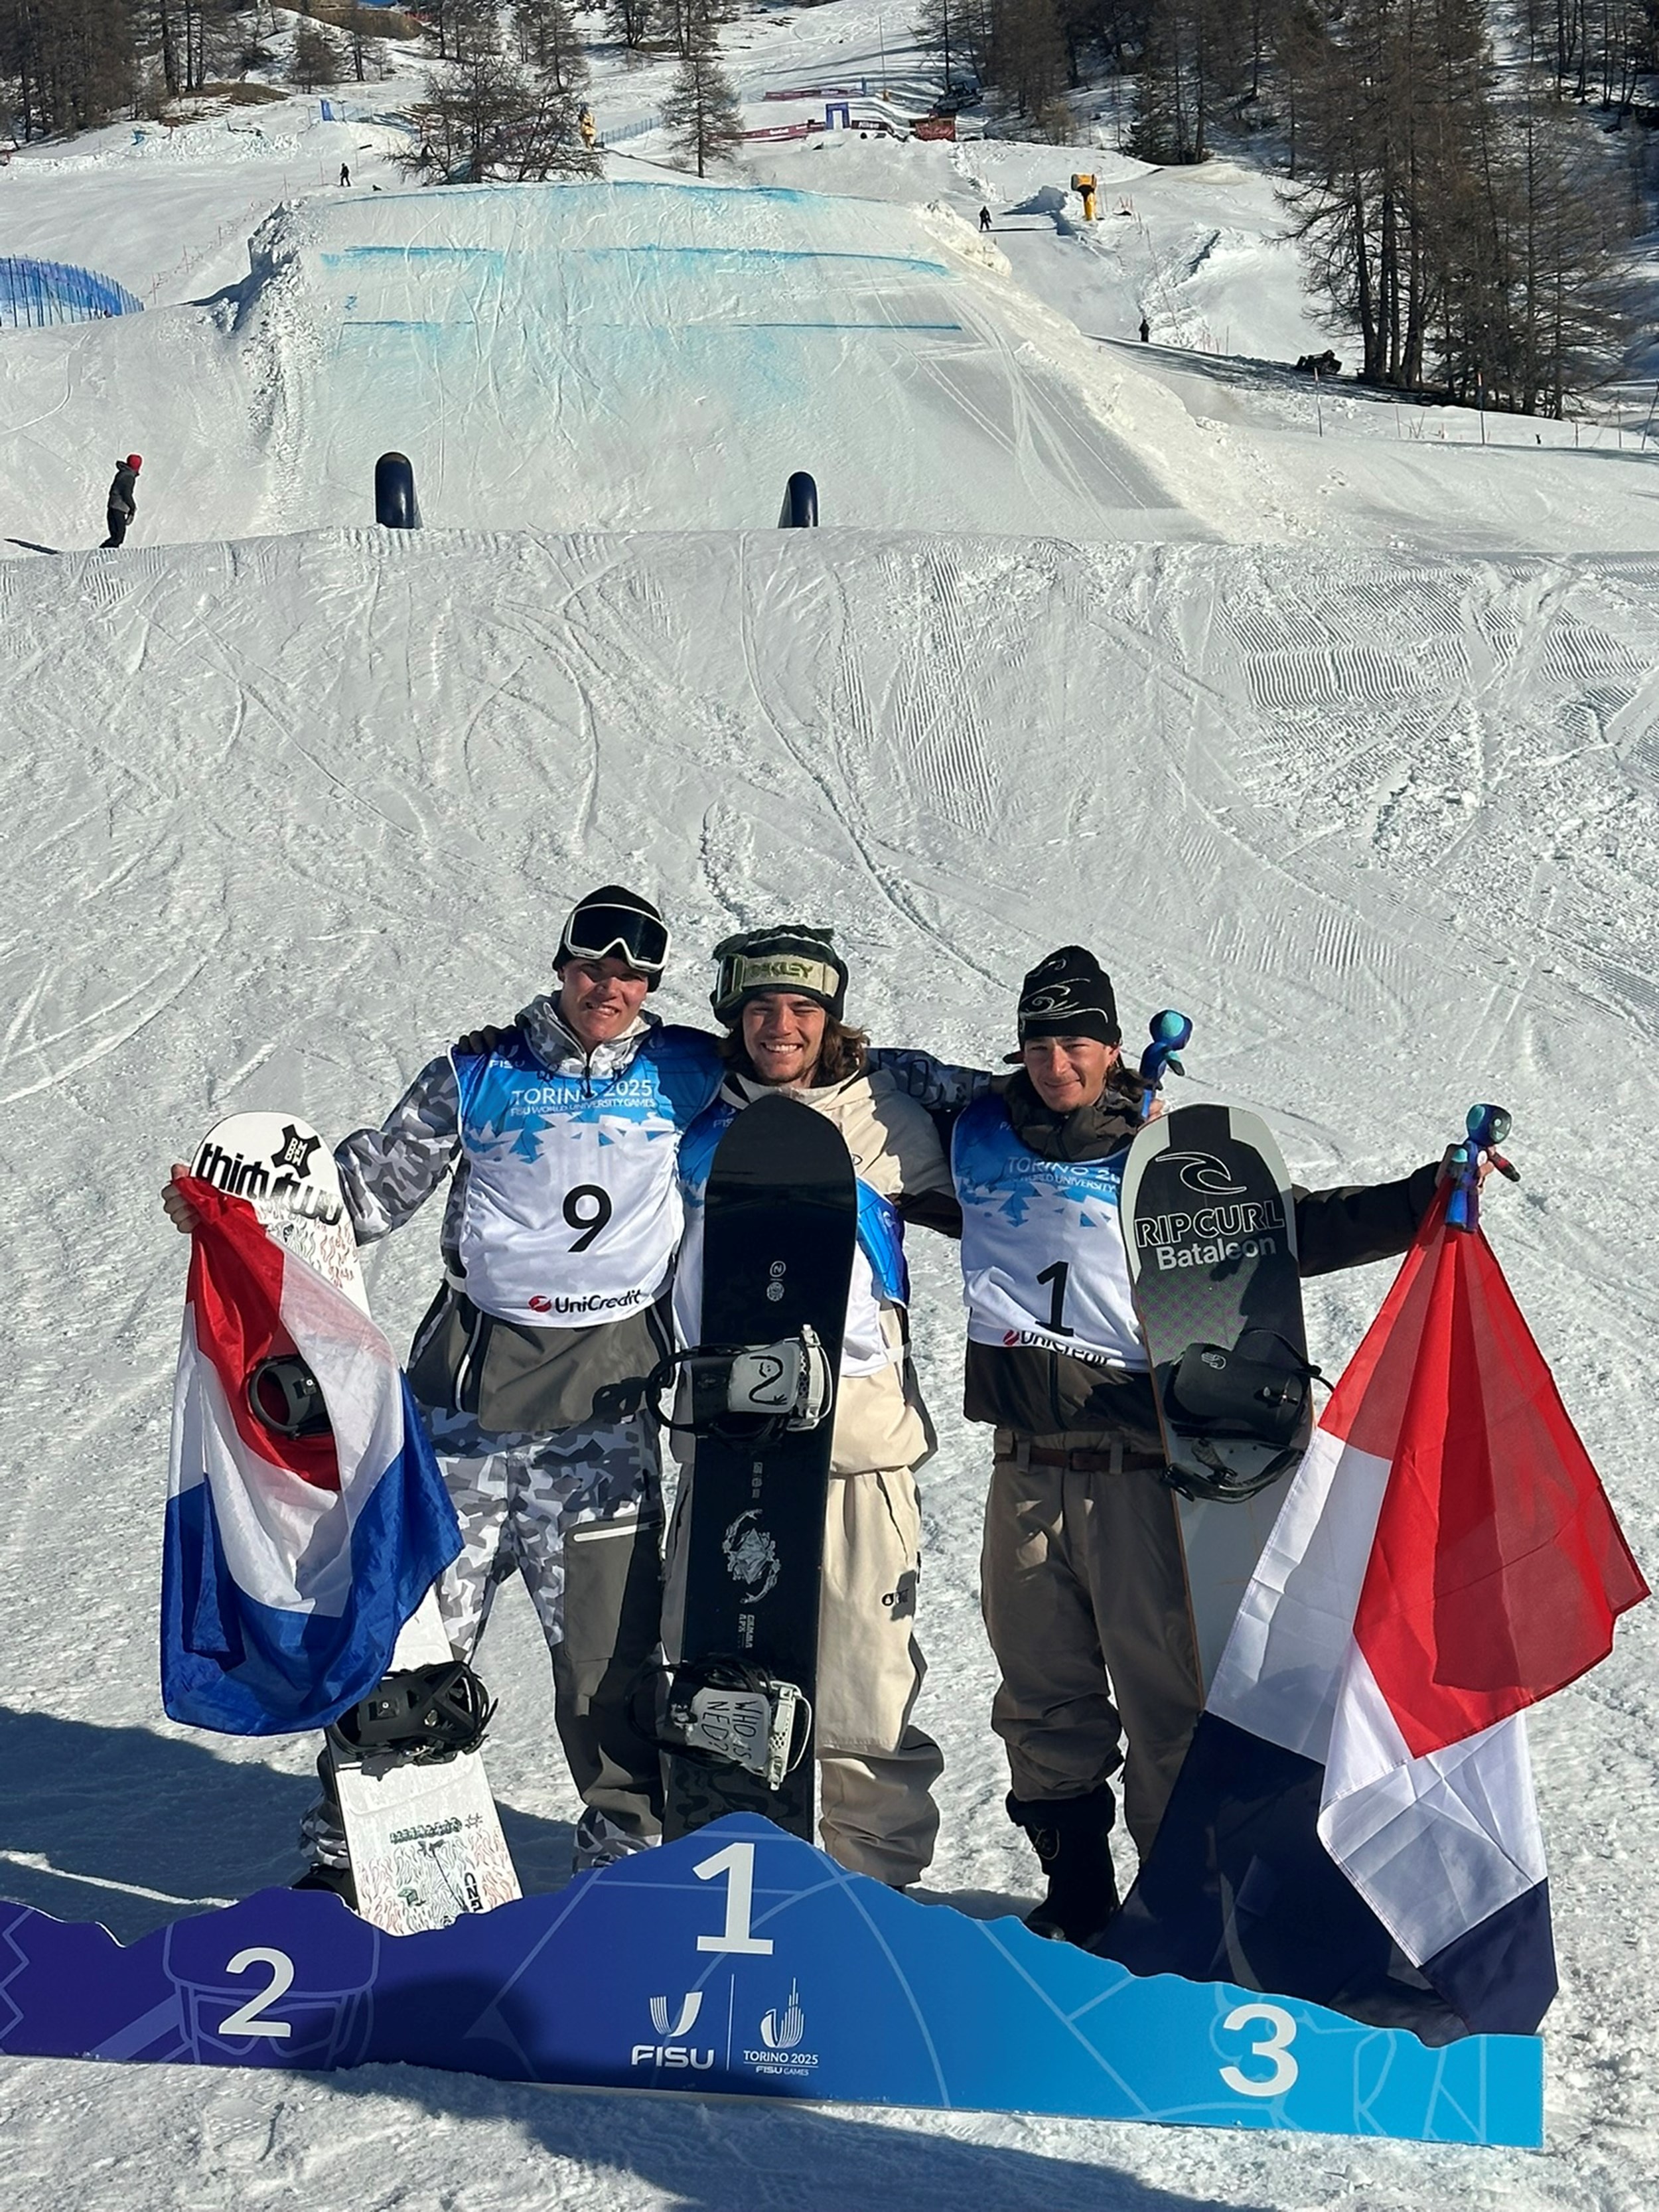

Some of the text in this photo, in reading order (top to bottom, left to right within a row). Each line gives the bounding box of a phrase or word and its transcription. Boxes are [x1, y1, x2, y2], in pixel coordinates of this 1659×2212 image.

[488, 1059, 525, 1069] FISU
[532, 1104, 569, 1114] WORLD
[569, 1097, 624, 1111] UNIVERSITY
[623, 1097, 656, 1108] GAMES
[603, 1079, 652, 1098] 2025
[562, 1184, 613, 1253] 9
[1135, 1203, 1285, 1248] RIP CURL
[1156, 1235, 1277, 1271] Bataleon
[555, 1289, 642, 1314] UniCredit
[1035, 1260, 1074, 1337] 1
[701, 1701, 731, 1752] NED?
[732, 1700, 763, 1738] WHO
[691, 1841, 774, 1955] 1
[218, 1946, 295, 2038] 2
[630, 2044, 715, 2070] FISU
[743, 2049, 818, 2065] TORINO 2025
[1218, 2003, 1299, 2097] 3
[755, 2065, 810, 2077] FISU GAMES
